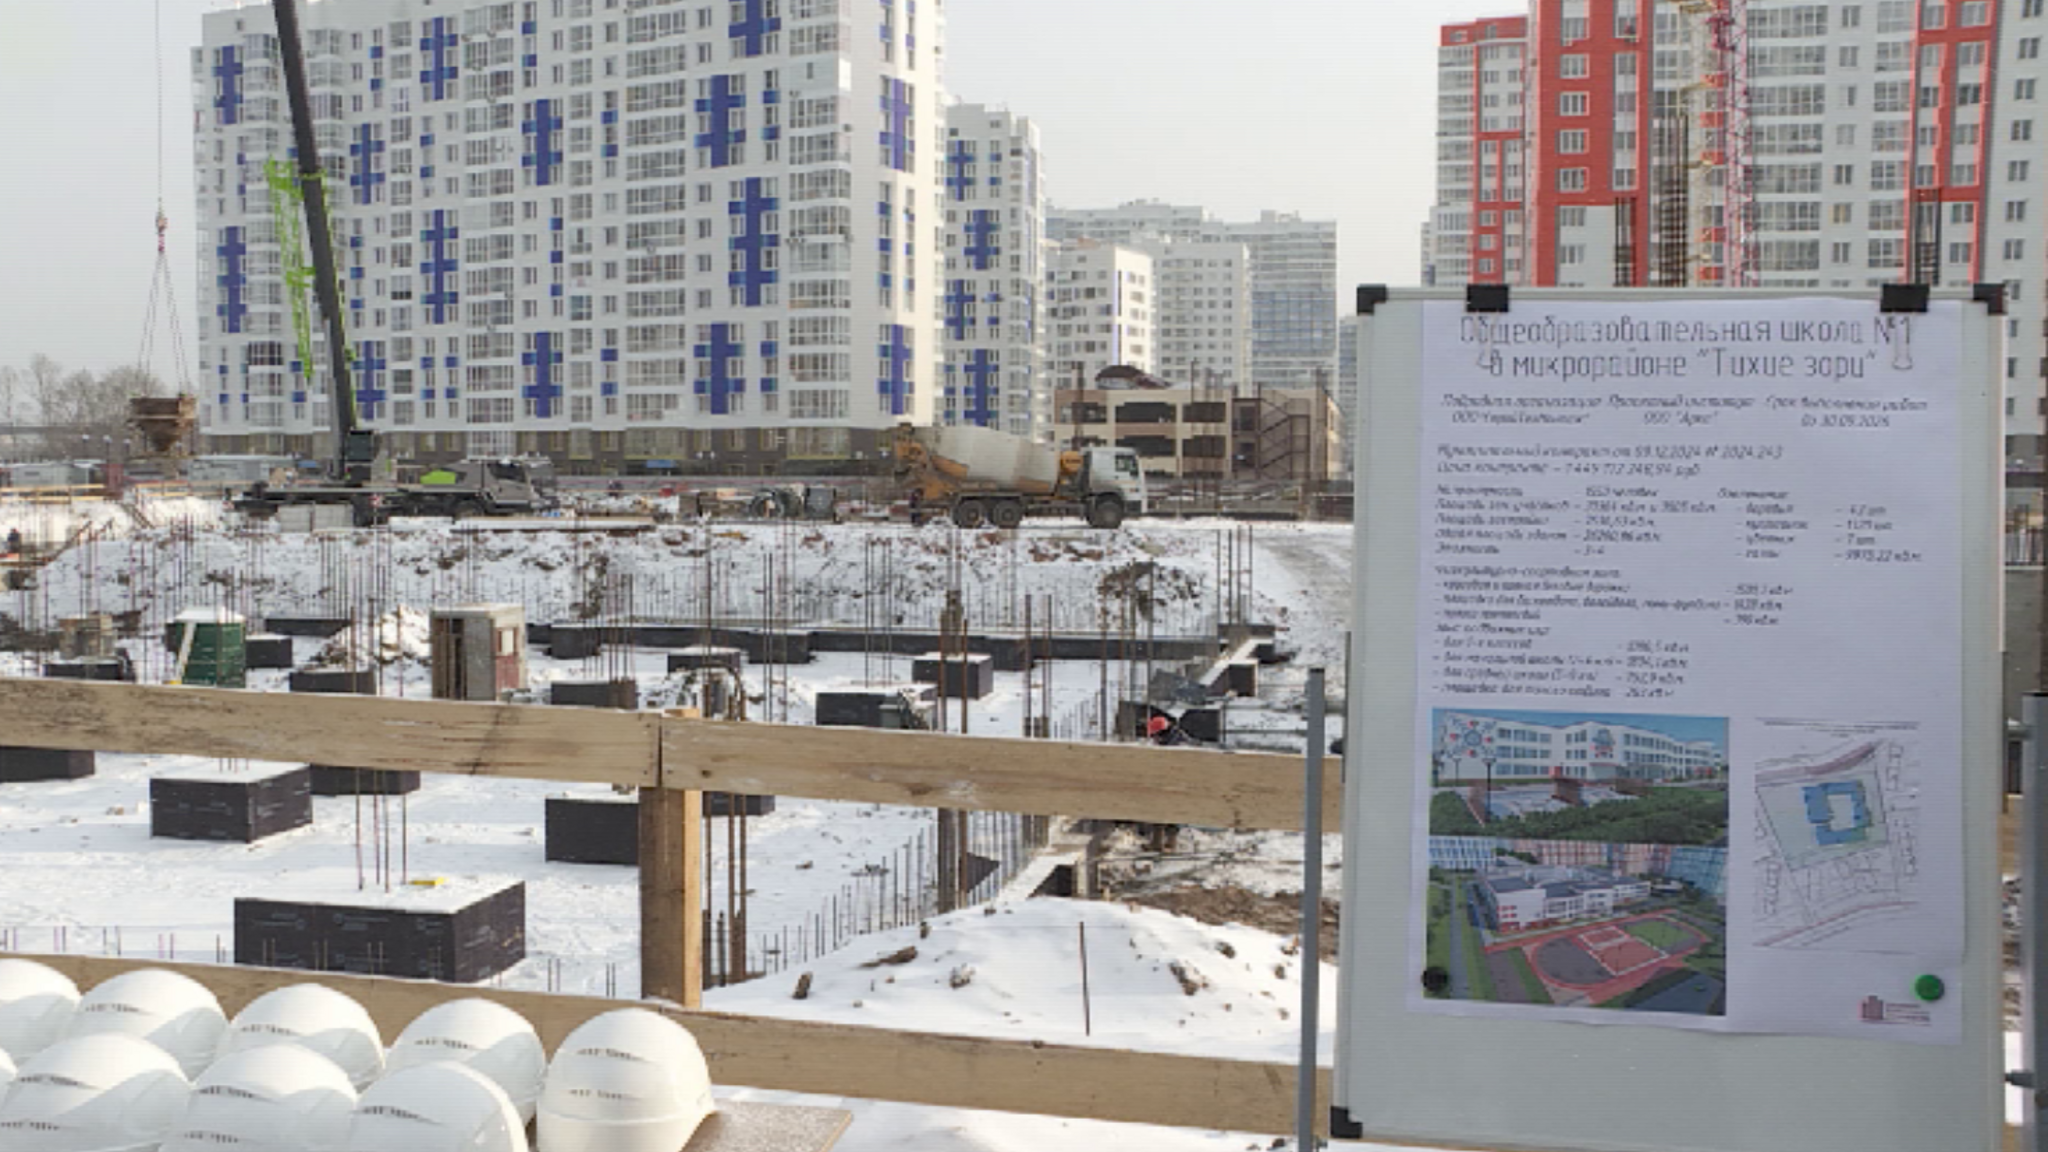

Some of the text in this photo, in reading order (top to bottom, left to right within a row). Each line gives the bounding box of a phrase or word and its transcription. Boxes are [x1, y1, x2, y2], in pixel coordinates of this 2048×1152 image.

[1460, 316, 1771, 348] Общеобразовательная
[1780, 319, 1865, 343] школа
[1512, 348, 1687, 381] микрорайоне
[1697, 348, 1795, 377] "Тихие
[1803, 350, 1876, 381] зори"
